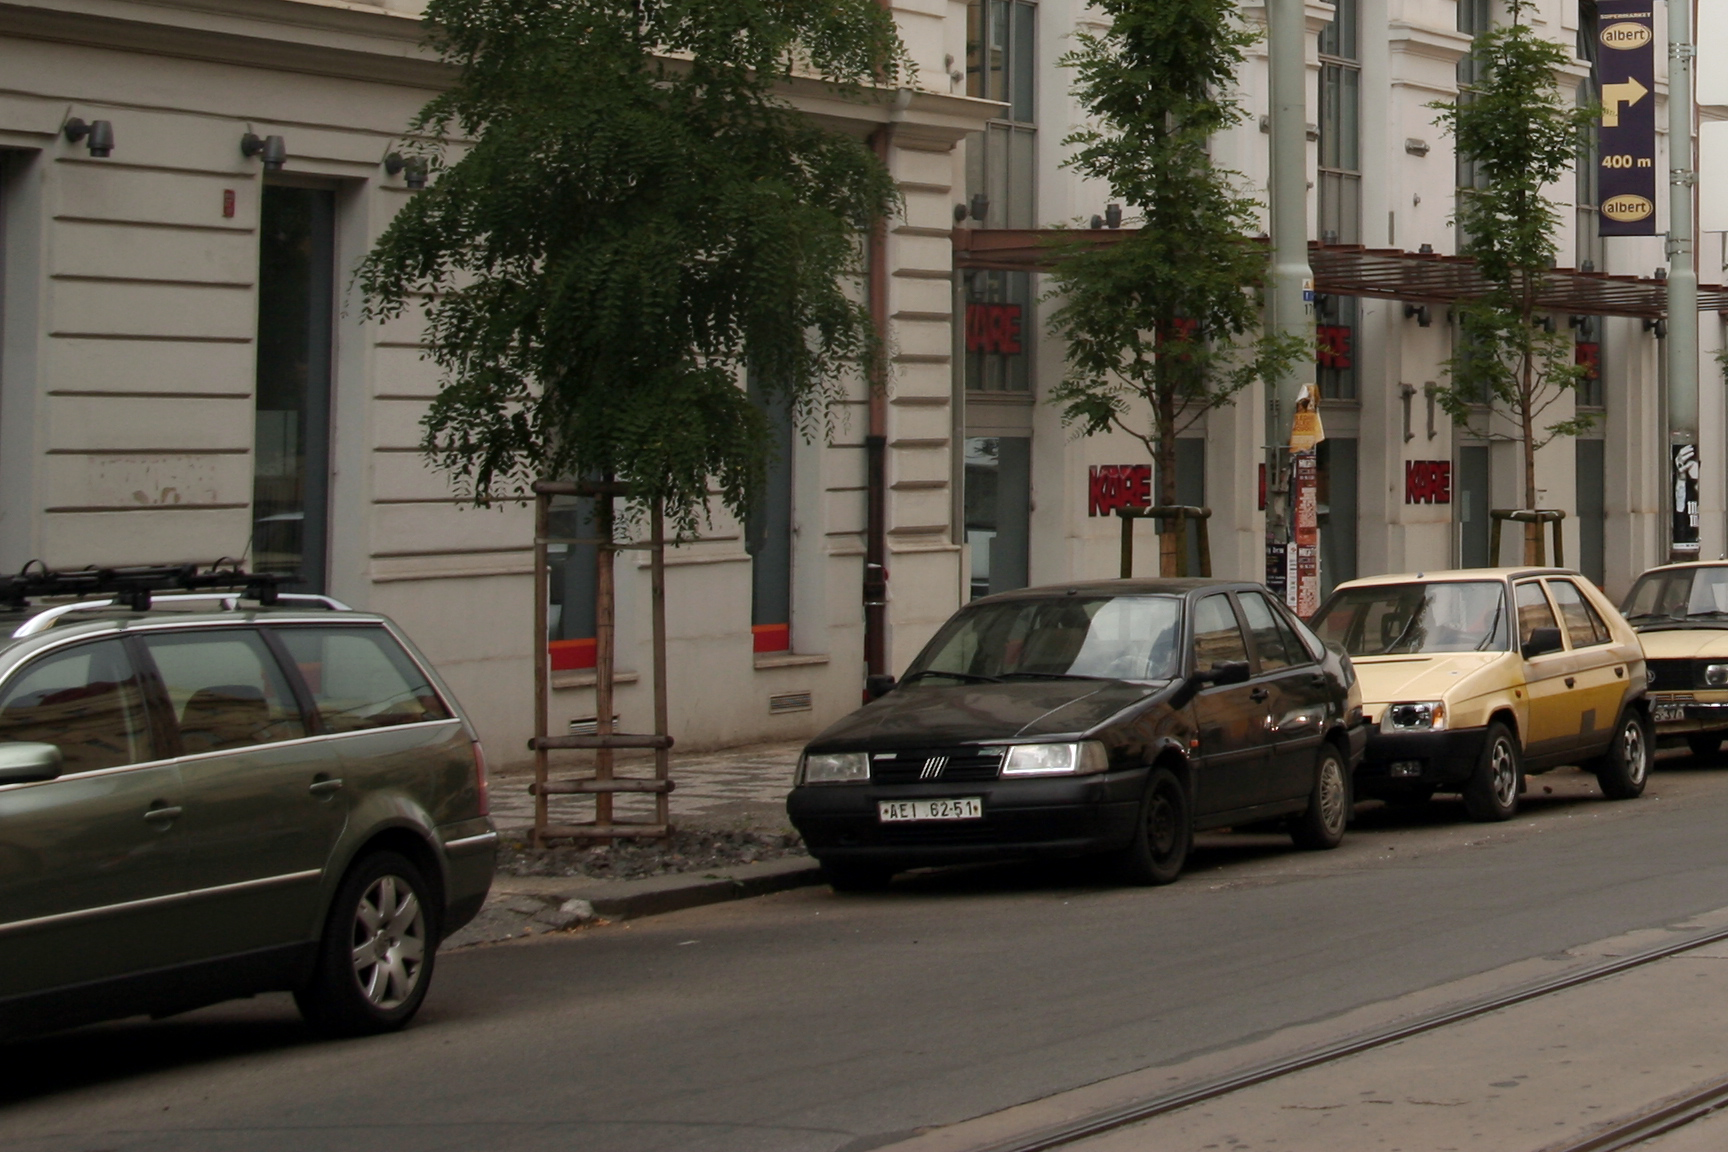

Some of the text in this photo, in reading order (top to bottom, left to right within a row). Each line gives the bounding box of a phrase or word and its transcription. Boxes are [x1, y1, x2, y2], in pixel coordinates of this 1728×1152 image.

[1605, 29, 1645, 42] albert
[1602, 155, 1652, 168] 400 m
[1607, 201, 1646, 213] albert
[1405, 460, 1453, 505] KARE
[1089, 465, 1152, 517] KARE
[890, 801, 972, 819] AEI 62-51
